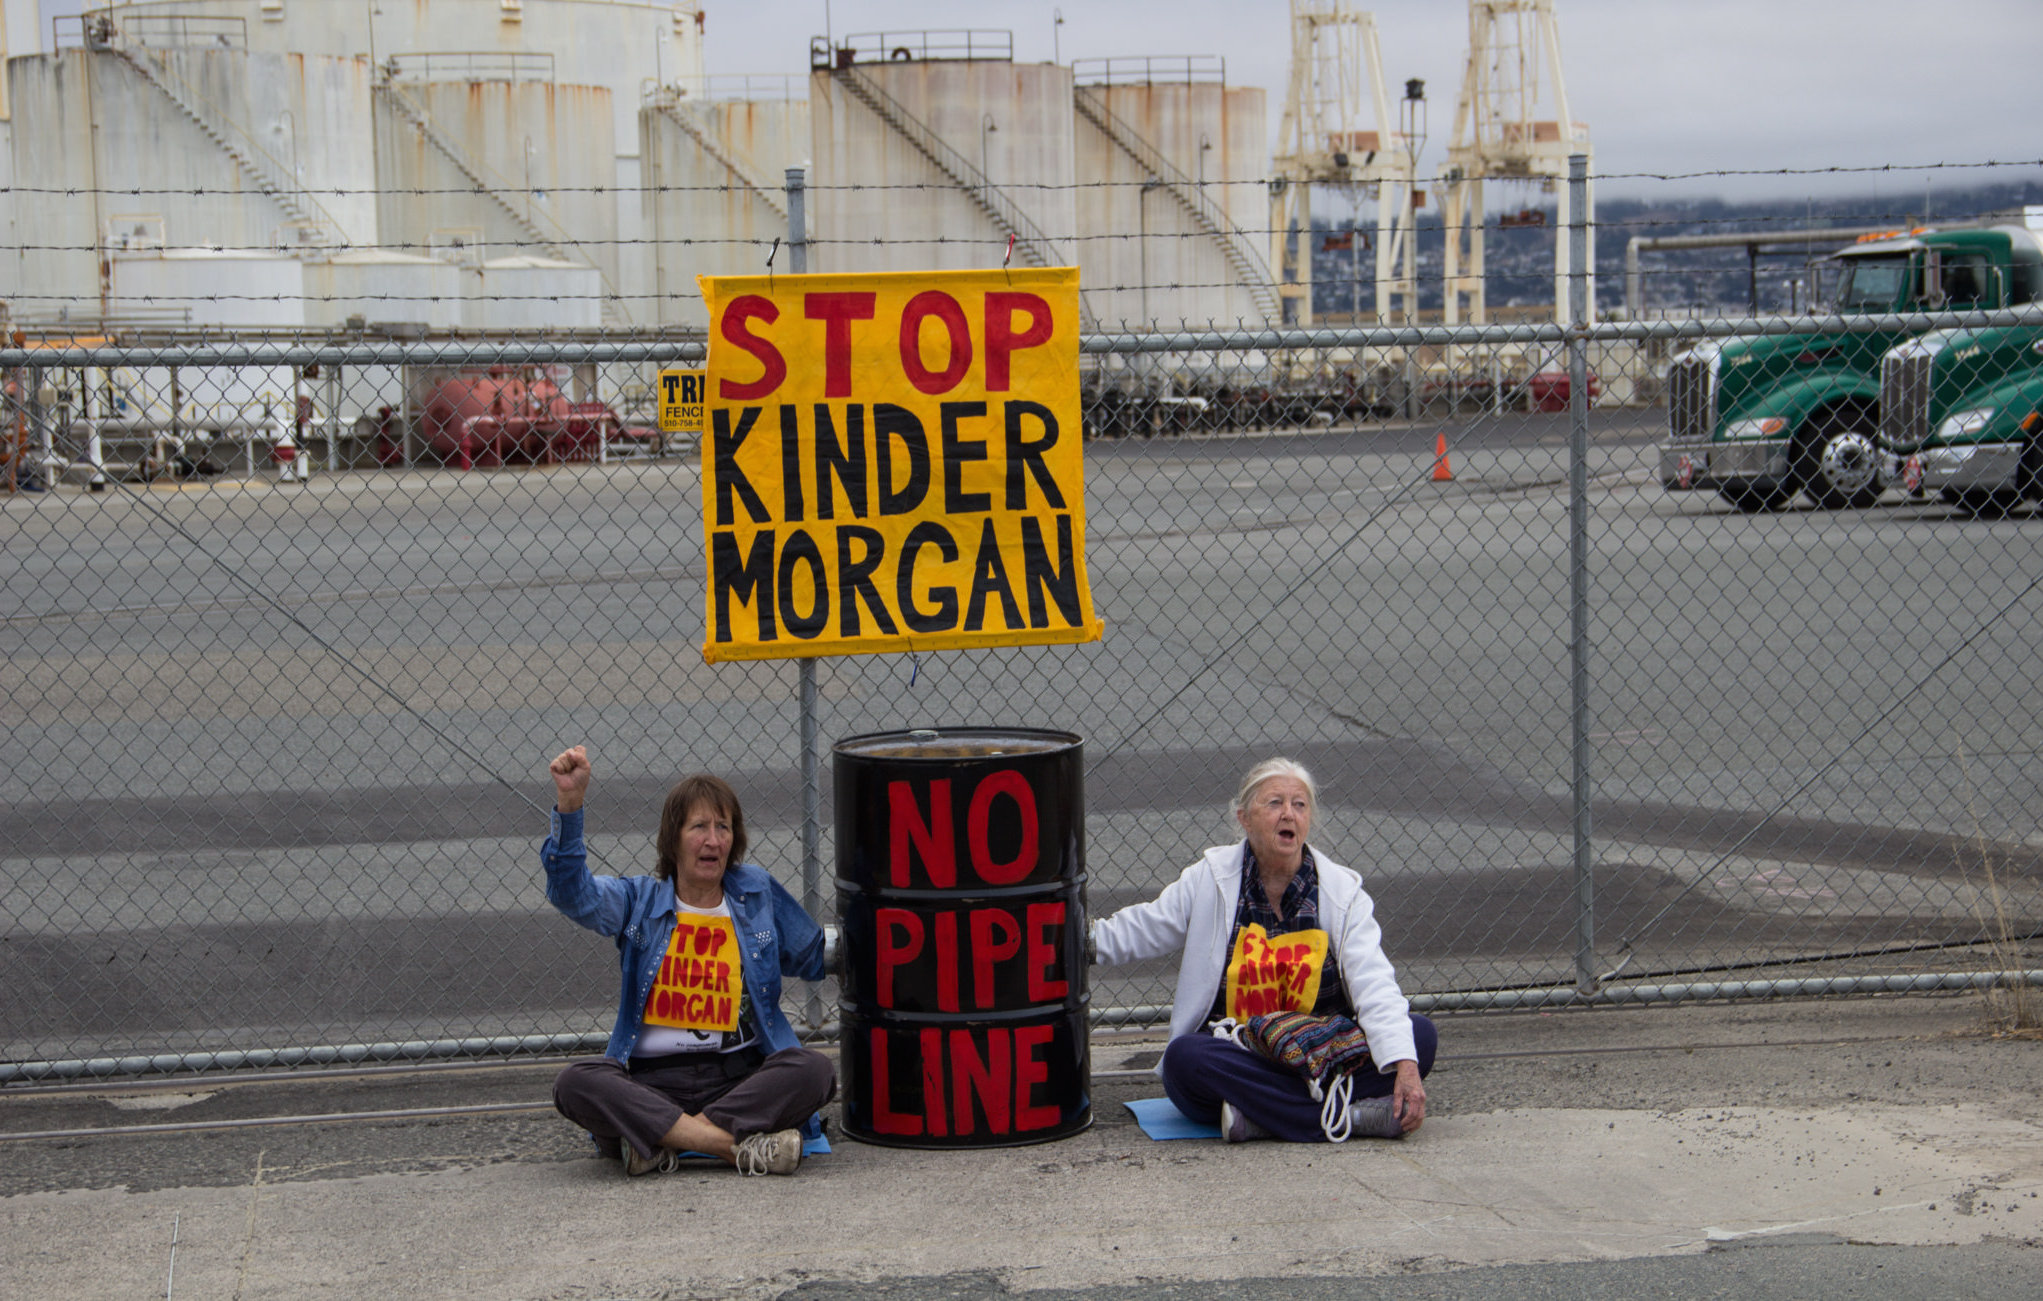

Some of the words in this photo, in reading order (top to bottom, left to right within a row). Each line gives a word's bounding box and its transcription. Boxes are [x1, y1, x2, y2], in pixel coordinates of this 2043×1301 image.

[719, 290, 1054, 400] STOP
[664, 419, 704, 428] 510-758-4
[712, 400, 1067, 526] KINDER
[712, 514, 1084, 643] MORGAN
[888, 769, 1040, 889] NO
[653, 955, 731, 994] INDER
[675, 923, 728, 958] TOP
[876, 902, 1069, 1013] PIPE
[871, 1024, 1062, 1137] LINE
